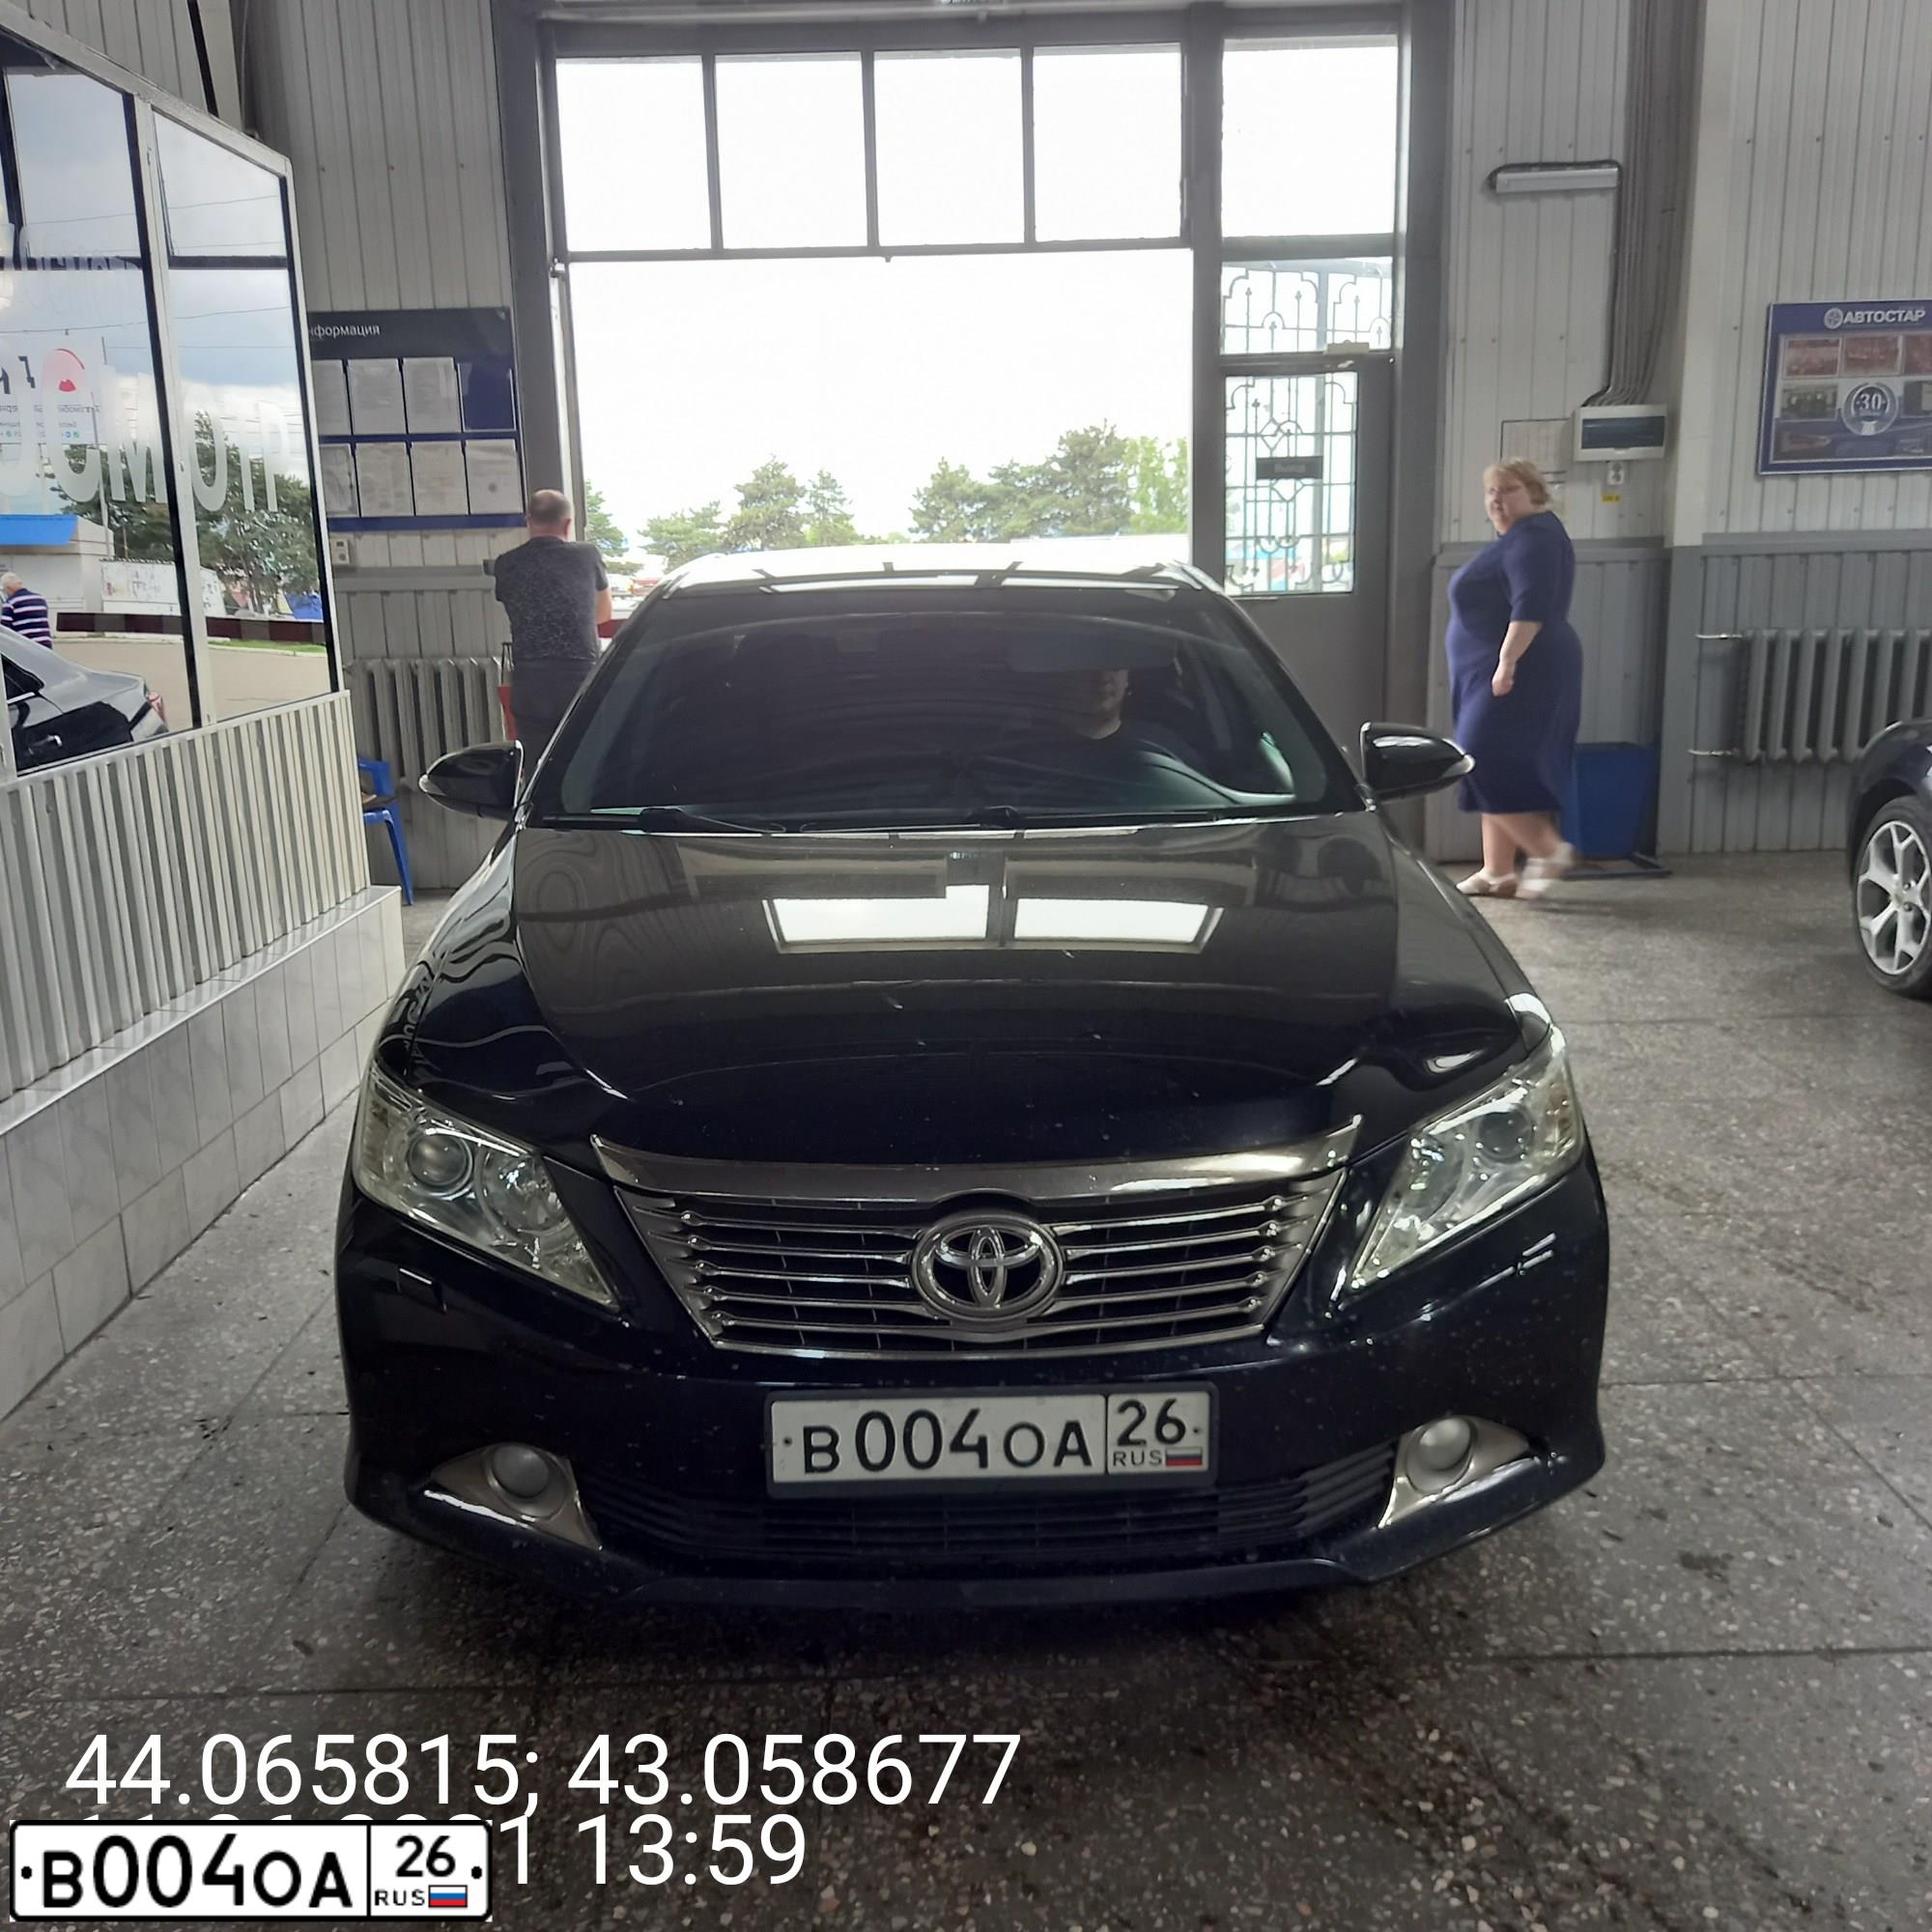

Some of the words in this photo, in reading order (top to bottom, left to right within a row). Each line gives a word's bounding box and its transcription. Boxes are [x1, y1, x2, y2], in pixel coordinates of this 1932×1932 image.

[1844, 309, 1925, 324] АВТОСТАР
[309, 324, 381, 339] нформация
[1859, 393, 1883, 411] 30
[803, 1408, 1093, 1474] В004ОА
[1117, 1399, 1185, 1446] 26
[1112, 1449, 1163, 1466] RUS
